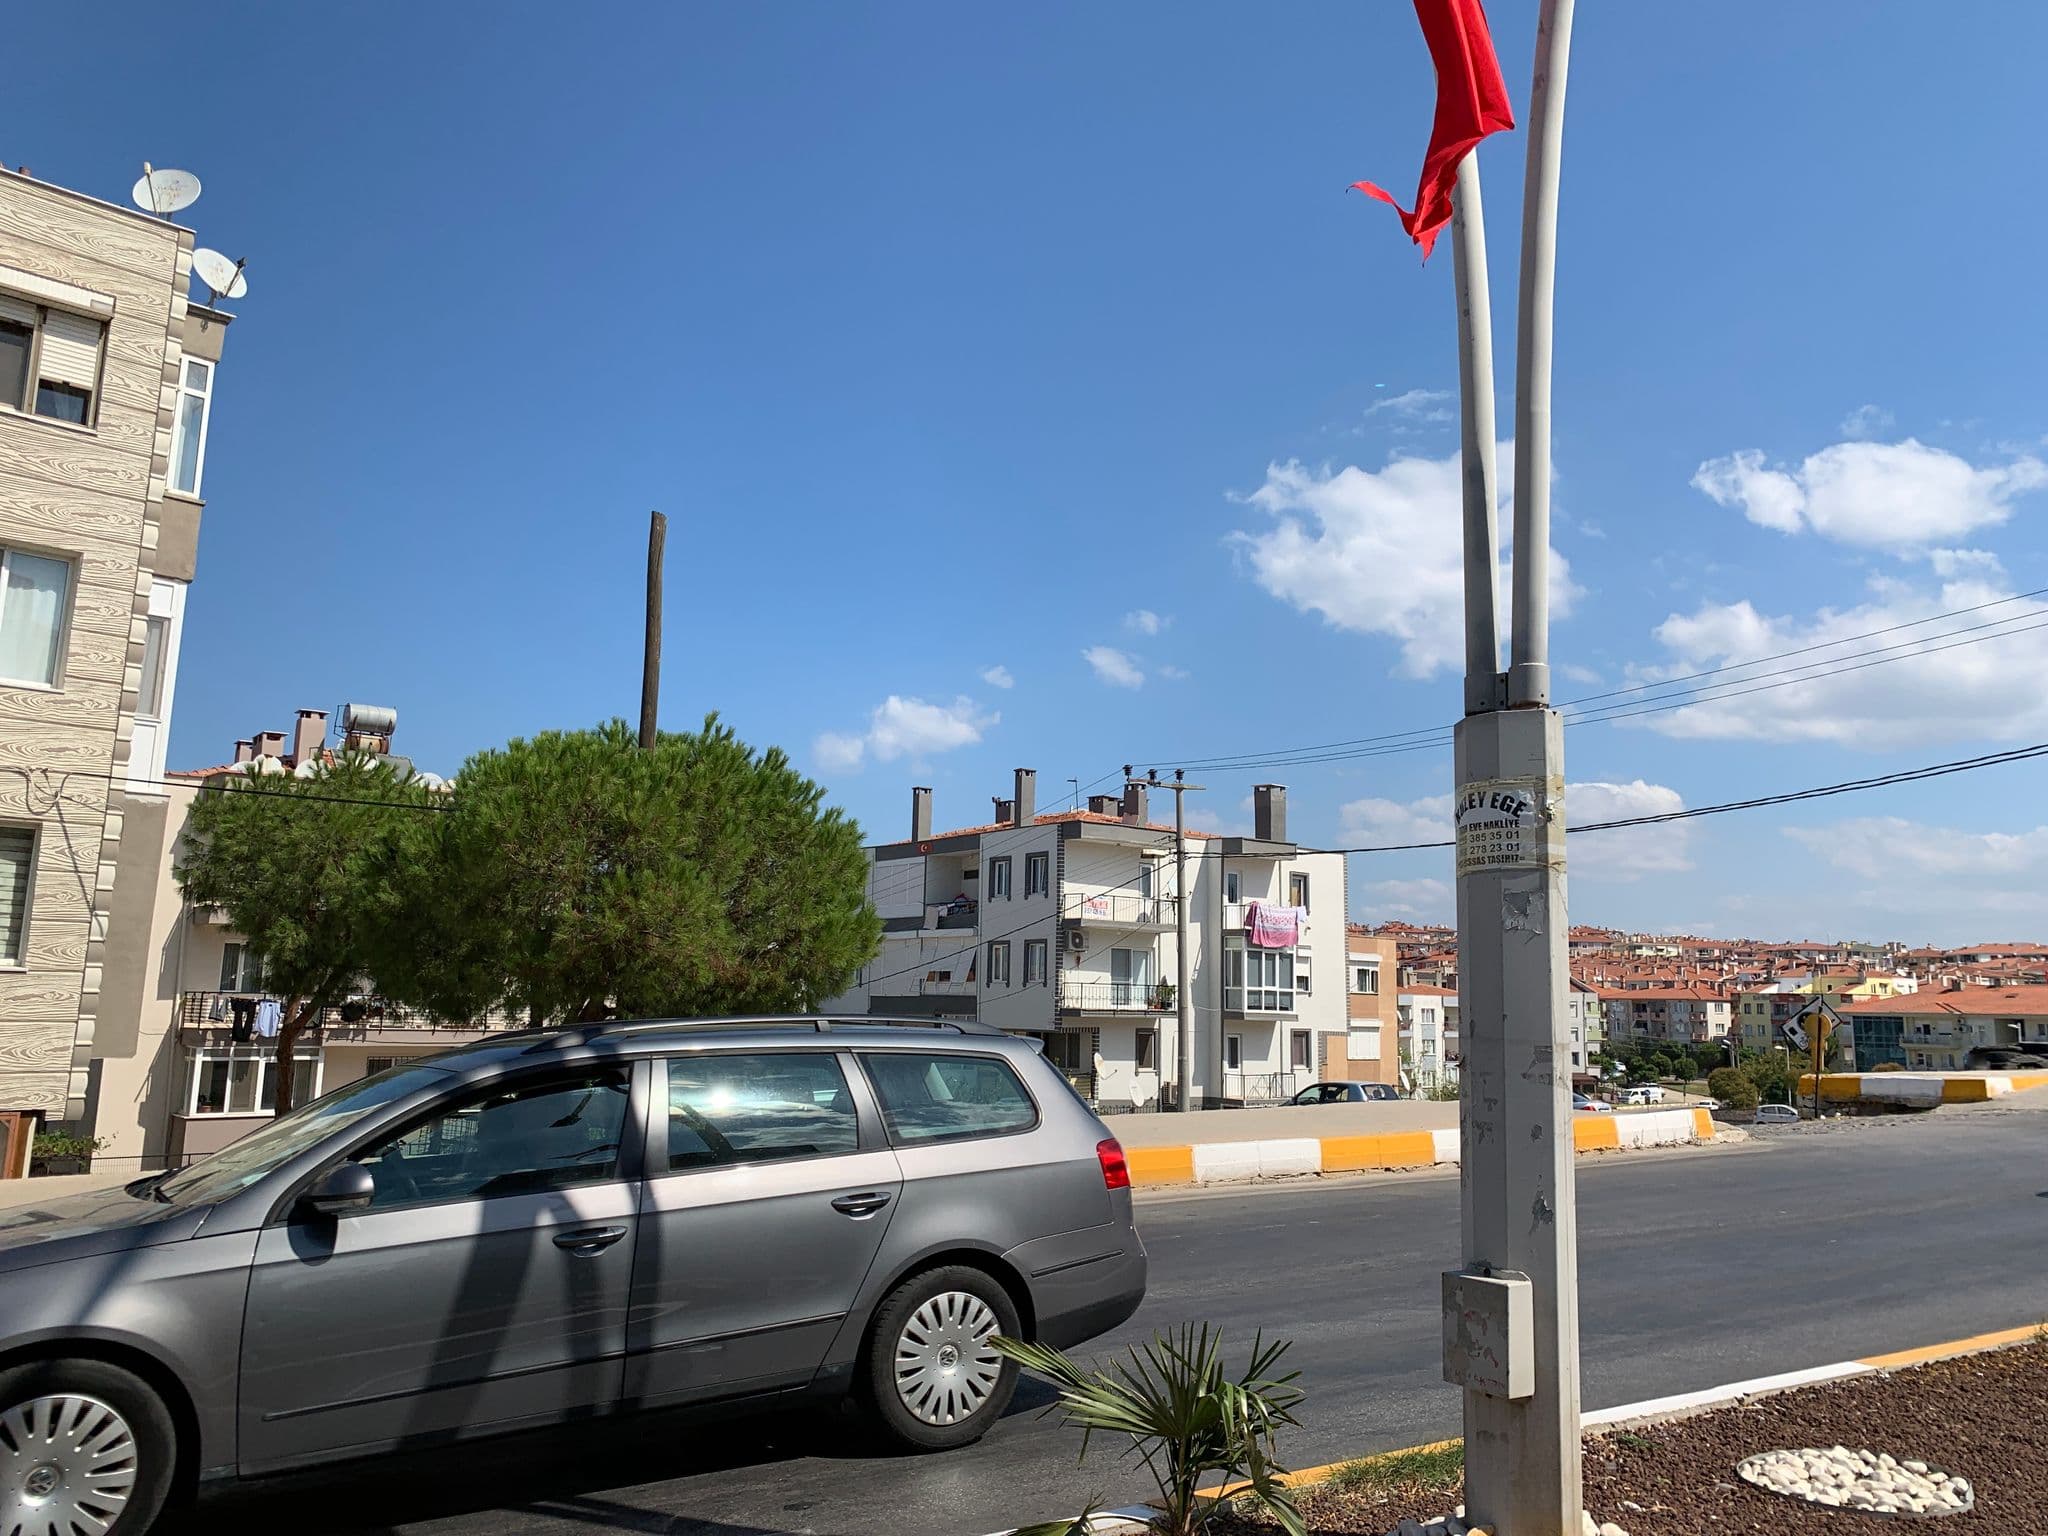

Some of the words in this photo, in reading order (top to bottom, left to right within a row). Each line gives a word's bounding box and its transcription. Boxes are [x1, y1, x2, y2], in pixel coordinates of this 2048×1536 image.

[1490, 792, 1527, 818] EGE
[1469, 823, 1482, 831] EVE
[1484, 818, 1520, 830] NAKLİYE
[1470, 833, 1486, 843] 385
[1490, 831, 1502, 840] 35
[1506, 831, 1520, 839] 01
[1470, 845, 1487, 854] 278
[1490, 843, 1502, 852] 23
[1507, 843, 1520, 851] 01
